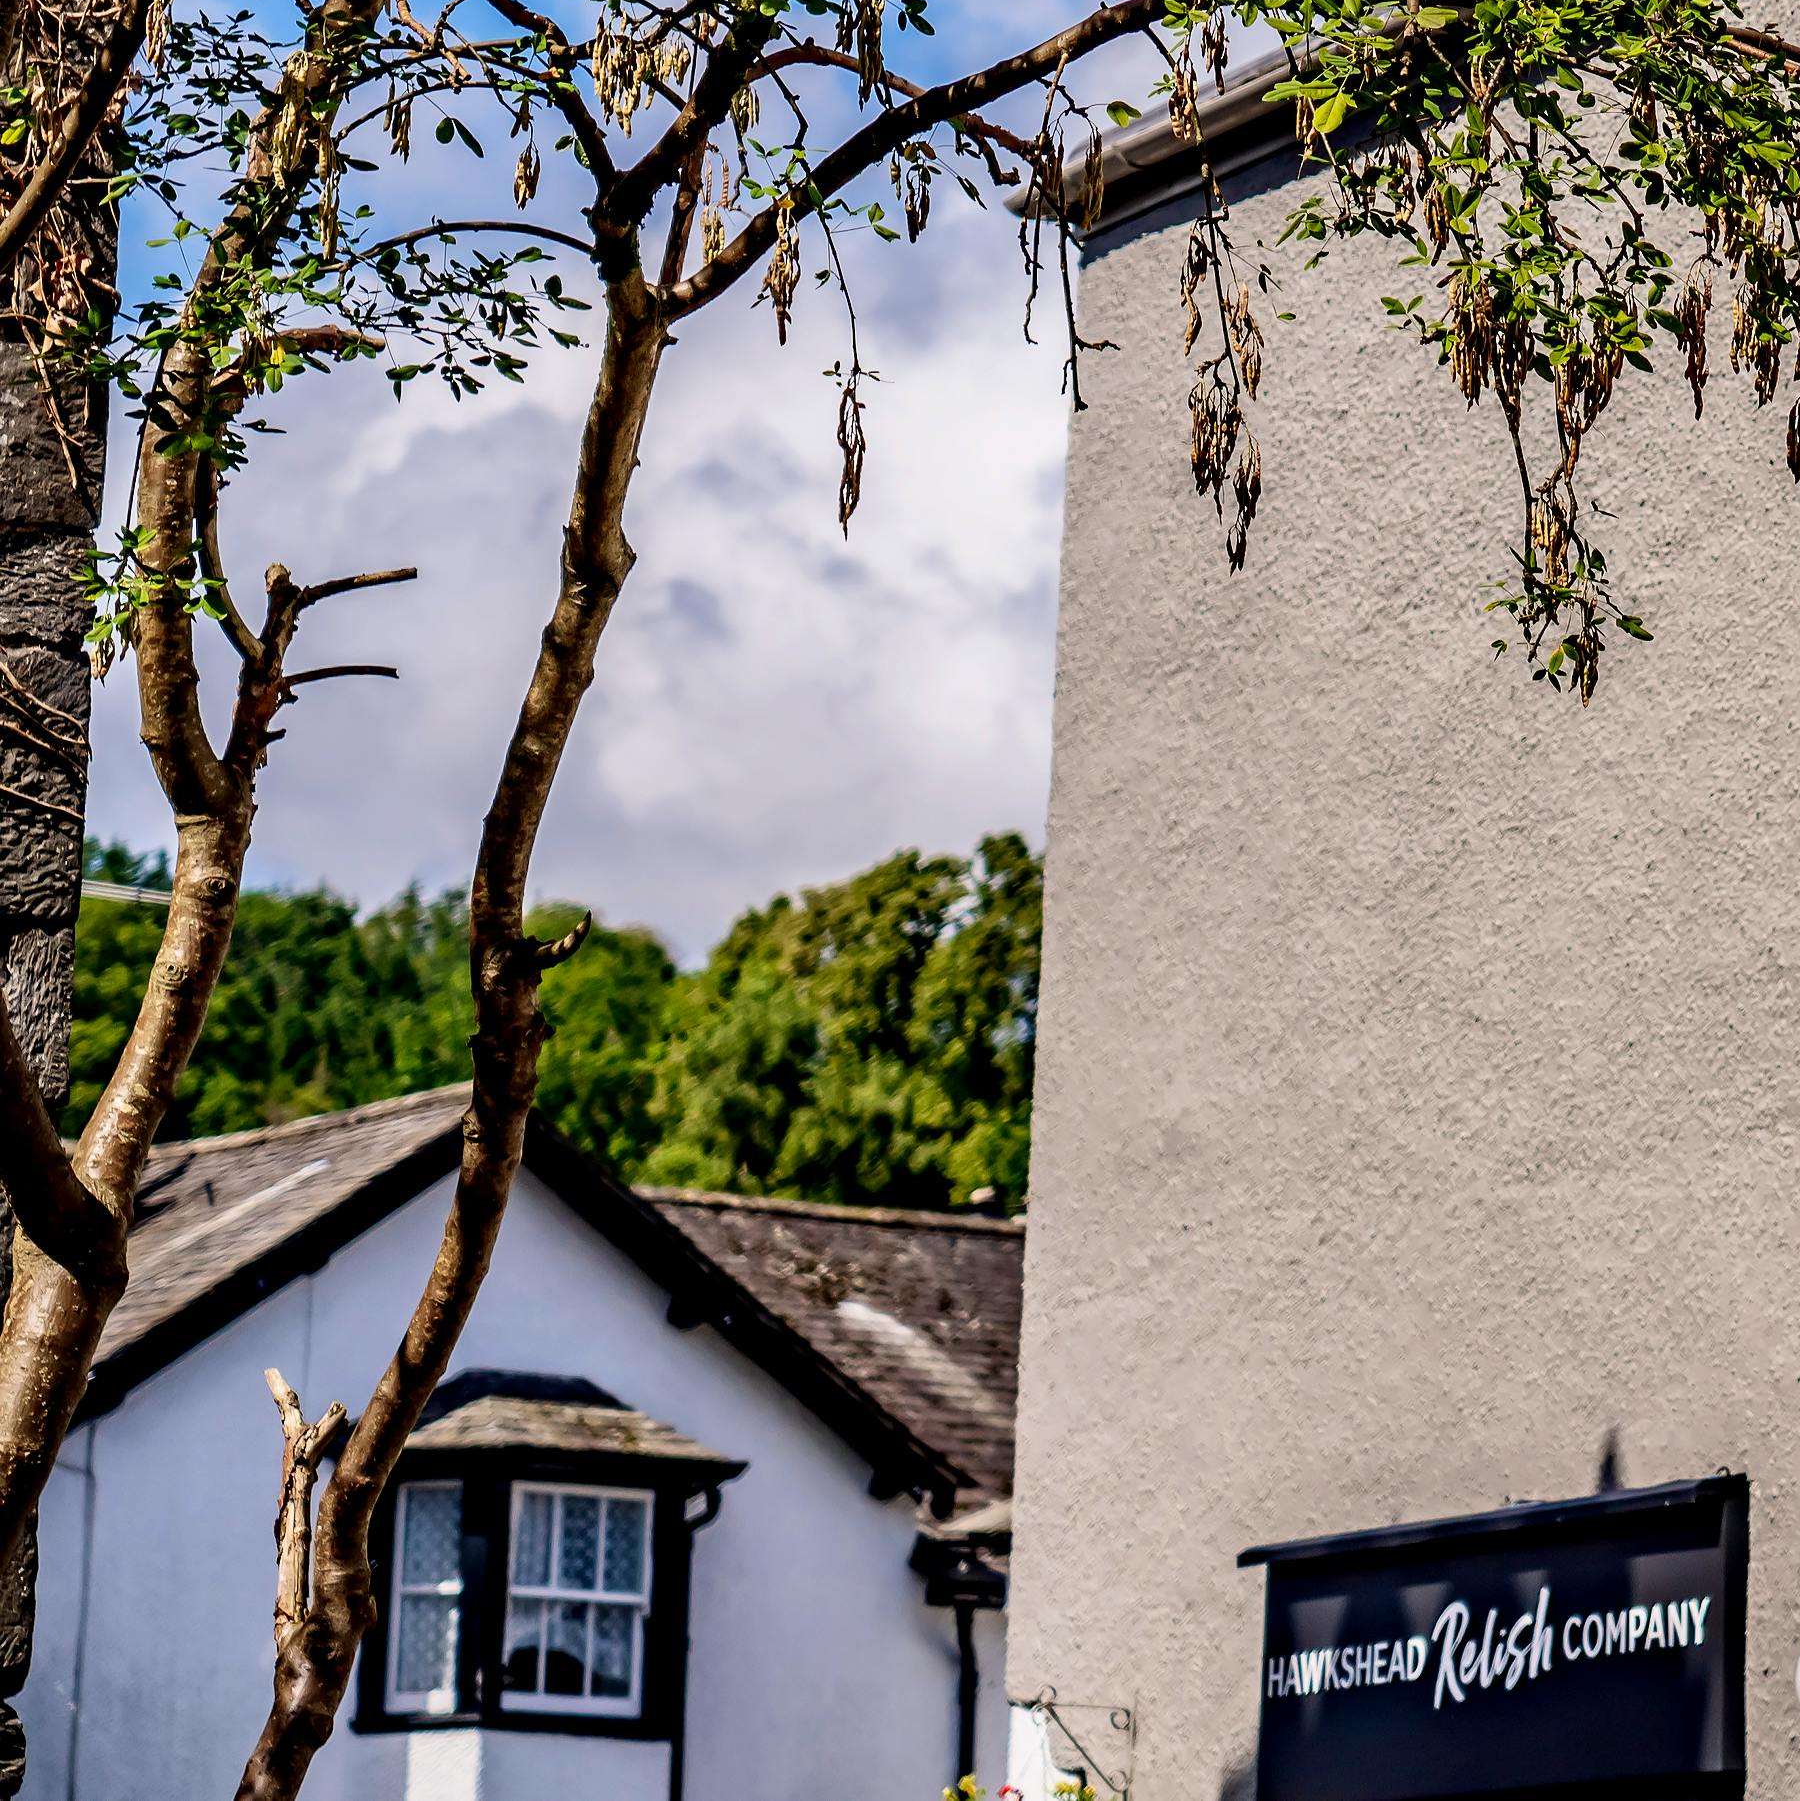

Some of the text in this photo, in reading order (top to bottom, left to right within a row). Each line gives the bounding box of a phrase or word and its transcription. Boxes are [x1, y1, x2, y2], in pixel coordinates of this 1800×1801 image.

[1267, 1586, 1711, 1710] HAWKSHEAD Relish COMPANY
